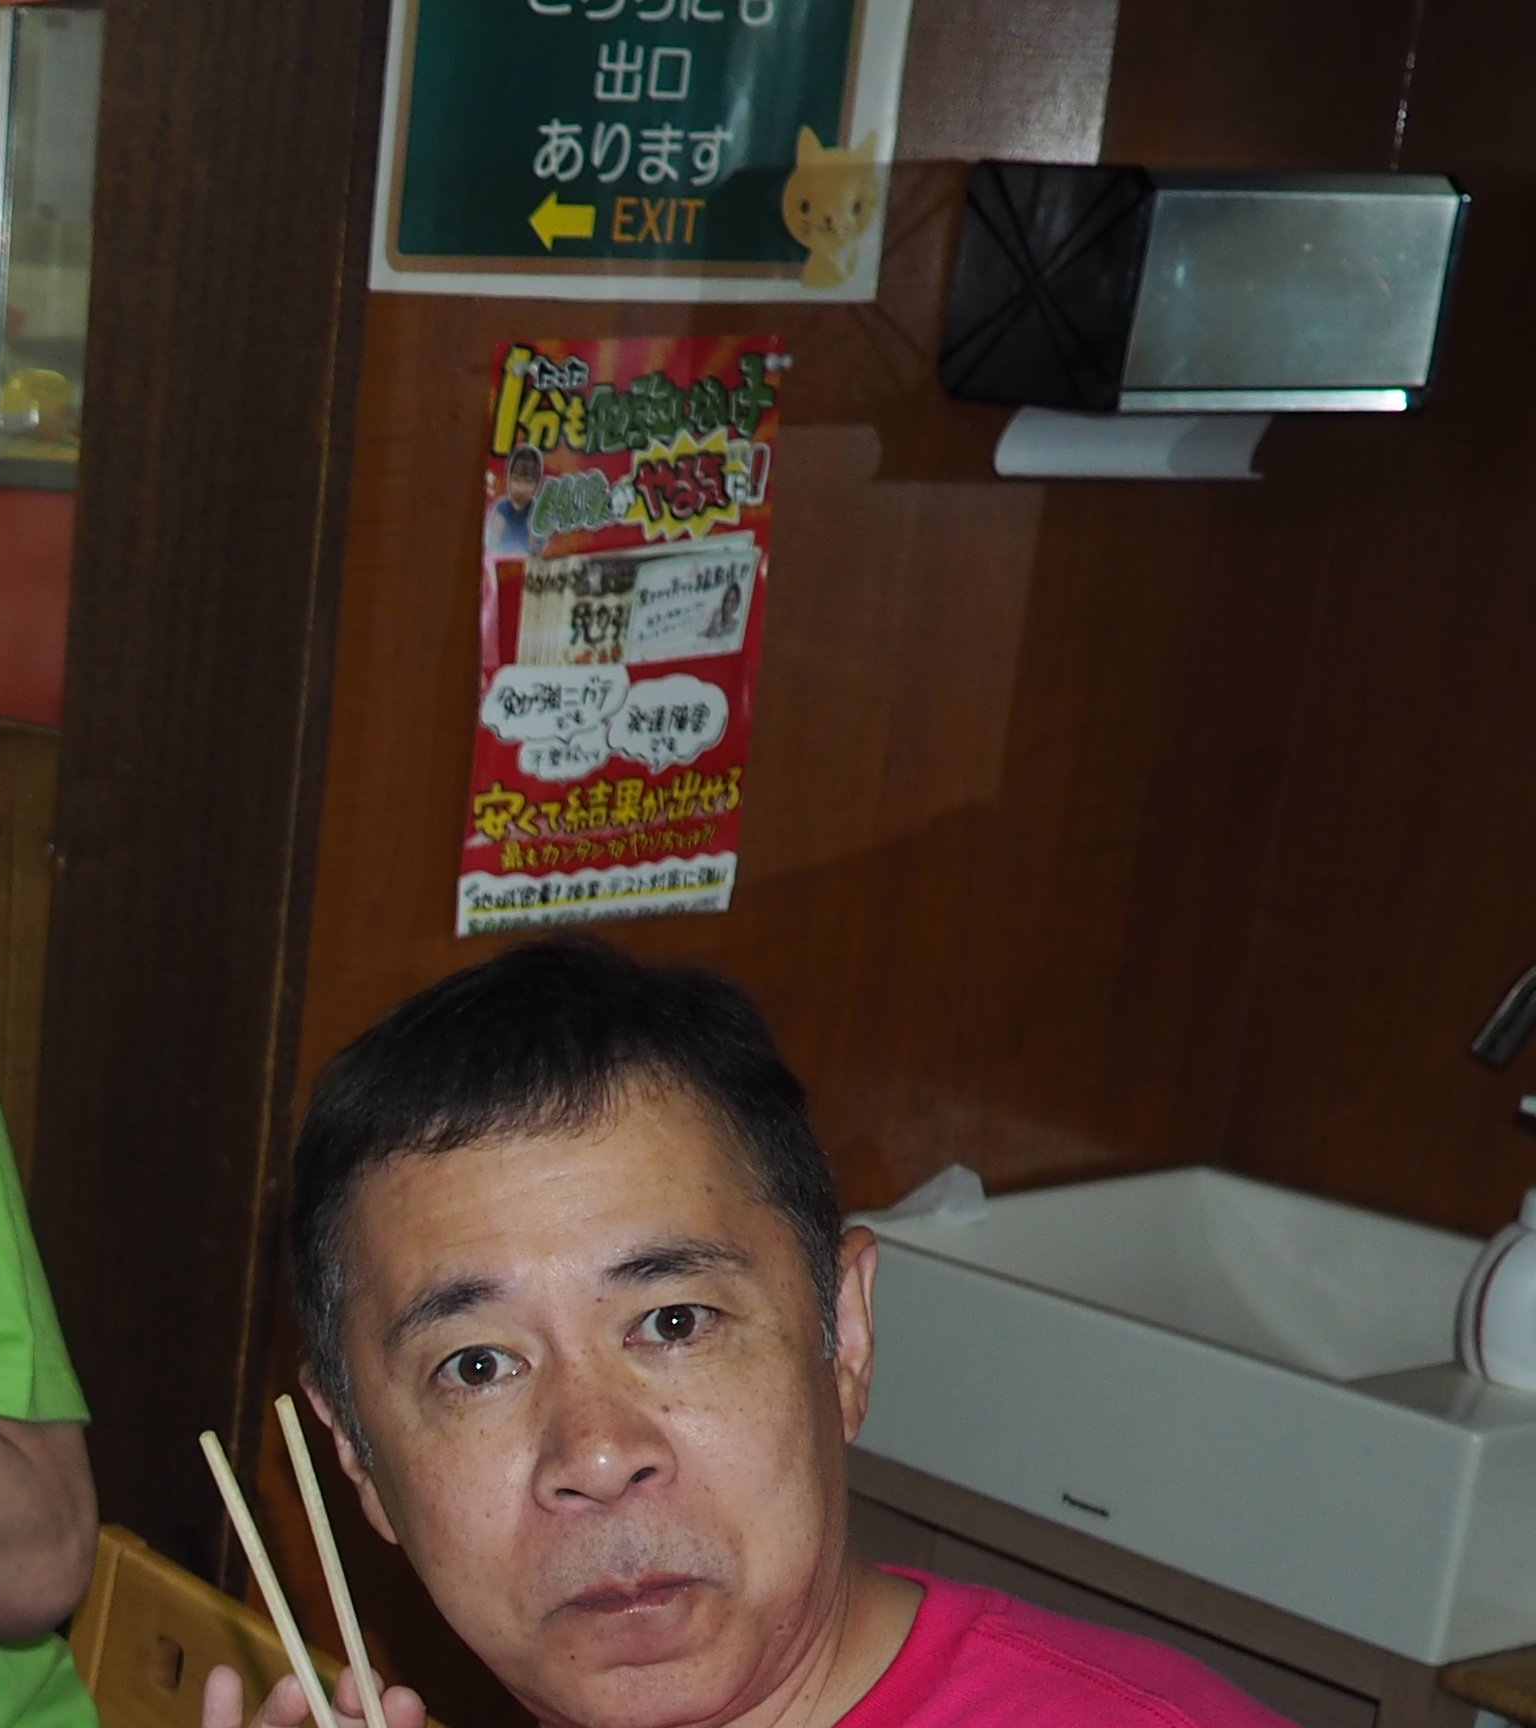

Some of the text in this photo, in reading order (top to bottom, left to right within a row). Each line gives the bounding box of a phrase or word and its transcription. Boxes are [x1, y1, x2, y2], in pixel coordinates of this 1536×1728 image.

[593, 39, 693, 102] 出口
[532, 117, 733, 186] あります
[611, 197, 706, 245] EXIT
